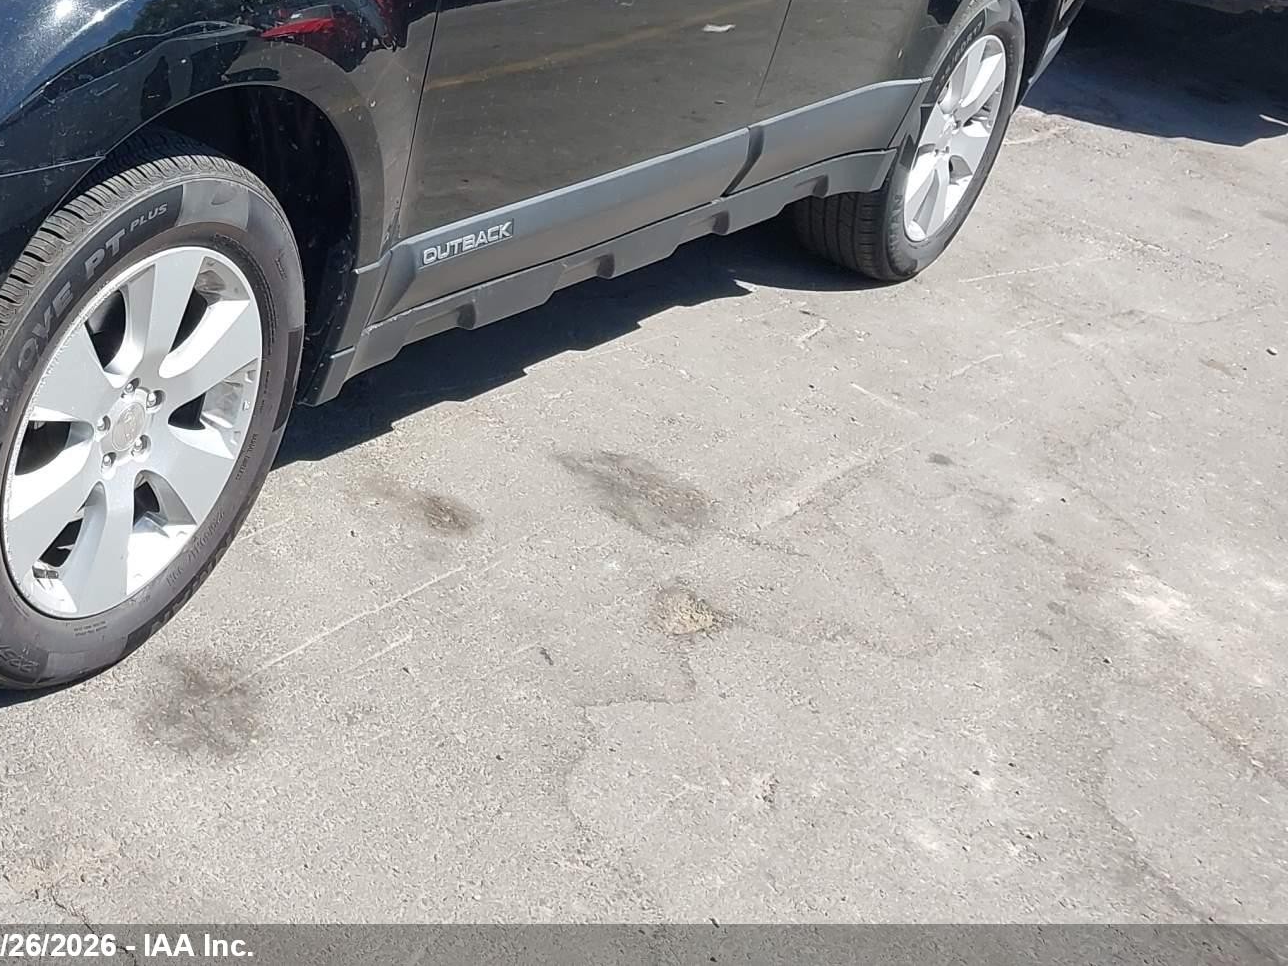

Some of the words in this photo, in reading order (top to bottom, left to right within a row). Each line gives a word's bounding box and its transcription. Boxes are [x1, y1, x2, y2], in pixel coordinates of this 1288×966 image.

[84, 228, 125, 279] PT
[130, 203, 168, 232] PLUS
[423, 221, 512, 265] OUTBACK
